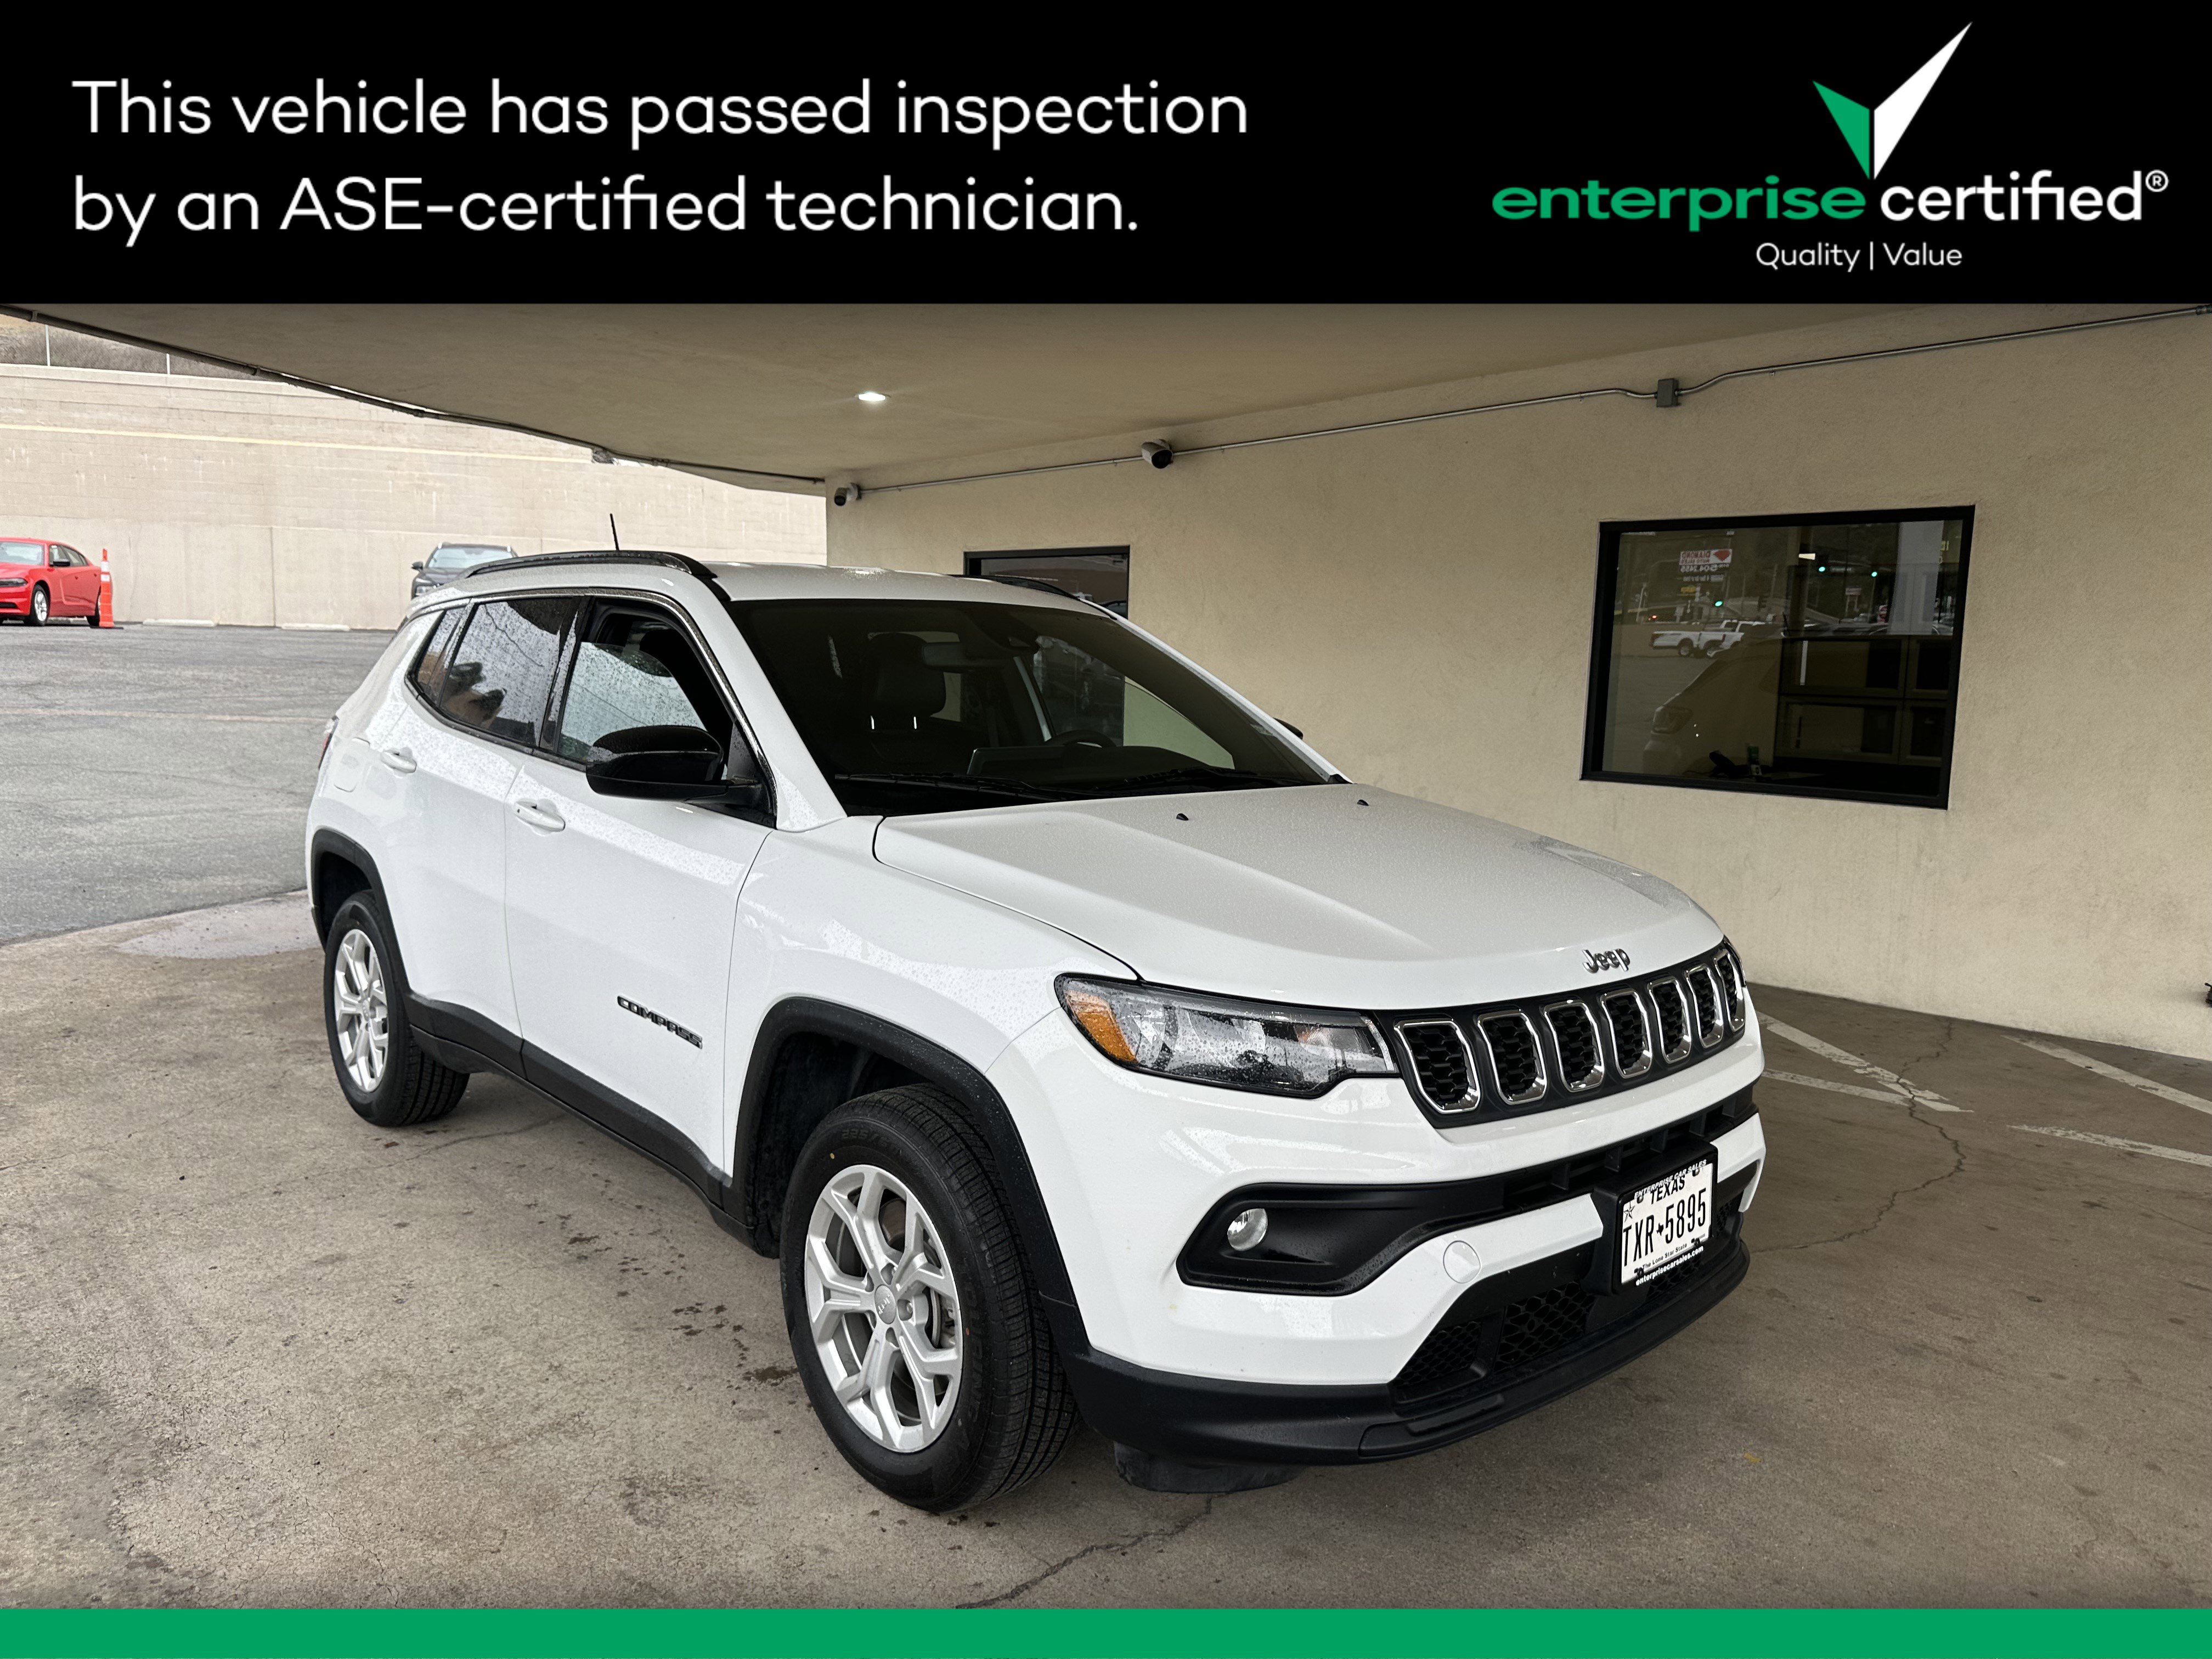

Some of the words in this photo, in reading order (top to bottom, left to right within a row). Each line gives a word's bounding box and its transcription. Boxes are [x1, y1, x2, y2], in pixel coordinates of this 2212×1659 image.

[1582, 949, 1630, 973] Jeep
[617, 995, 703, 1049] COMPASS
[1634, 1175, 1673, 1200] ENTERPRISE
[1674, 1169, 1687, 1180] CAR
[1688, 1159, 1707, 1173] SALES
[1650, 1176, 1685, 1205] TEXAS
[1636, 1245, 1704, 1286] enterprisecarsales.com
[1652, 1256, 1663, 1265] Lone
[1664, 1249, 1674, 1259] Star
[1675, 1243, 1688, 1252] State
